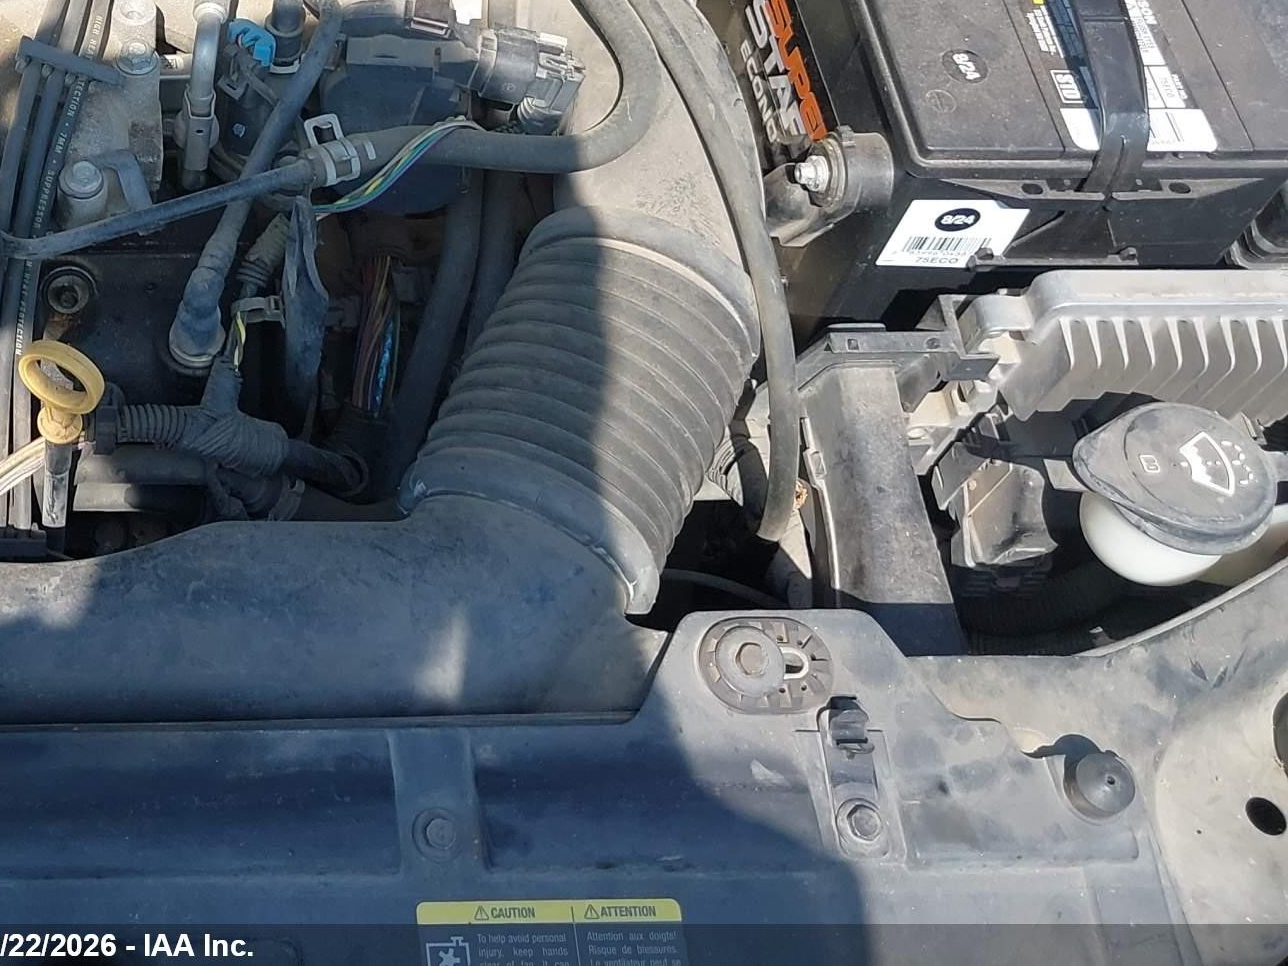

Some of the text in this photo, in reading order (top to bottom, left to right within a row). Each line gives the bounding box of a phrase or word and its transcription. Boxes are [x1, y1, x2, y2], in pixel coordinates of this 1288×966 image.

[92, 15, 105, 36] HIGH
[952, 53, 981, 80] 8/24
[740, 39, 778, 143] ECONO
[67, 78, 86, 117] TECTION
[55, 132, 68, 154] 7MM
[32, 169, 56, 229] SUPPRESSOR
[940, 214, 976, 225] 8/24
[915, 256, 959, 264] 75ECO
[491, 907, 536, 919] CAUTION
[600, 905, 657, 917] ATTENTION
[478, 933, 567, 946] To help avoid personal
[587, 931, 624, 941] Attention
[513, 947, 534, 958] keep
[542, 946, 569, 956] hands
[588, 945, 617, 956] Risque
[621, 944, 632, 954] de
